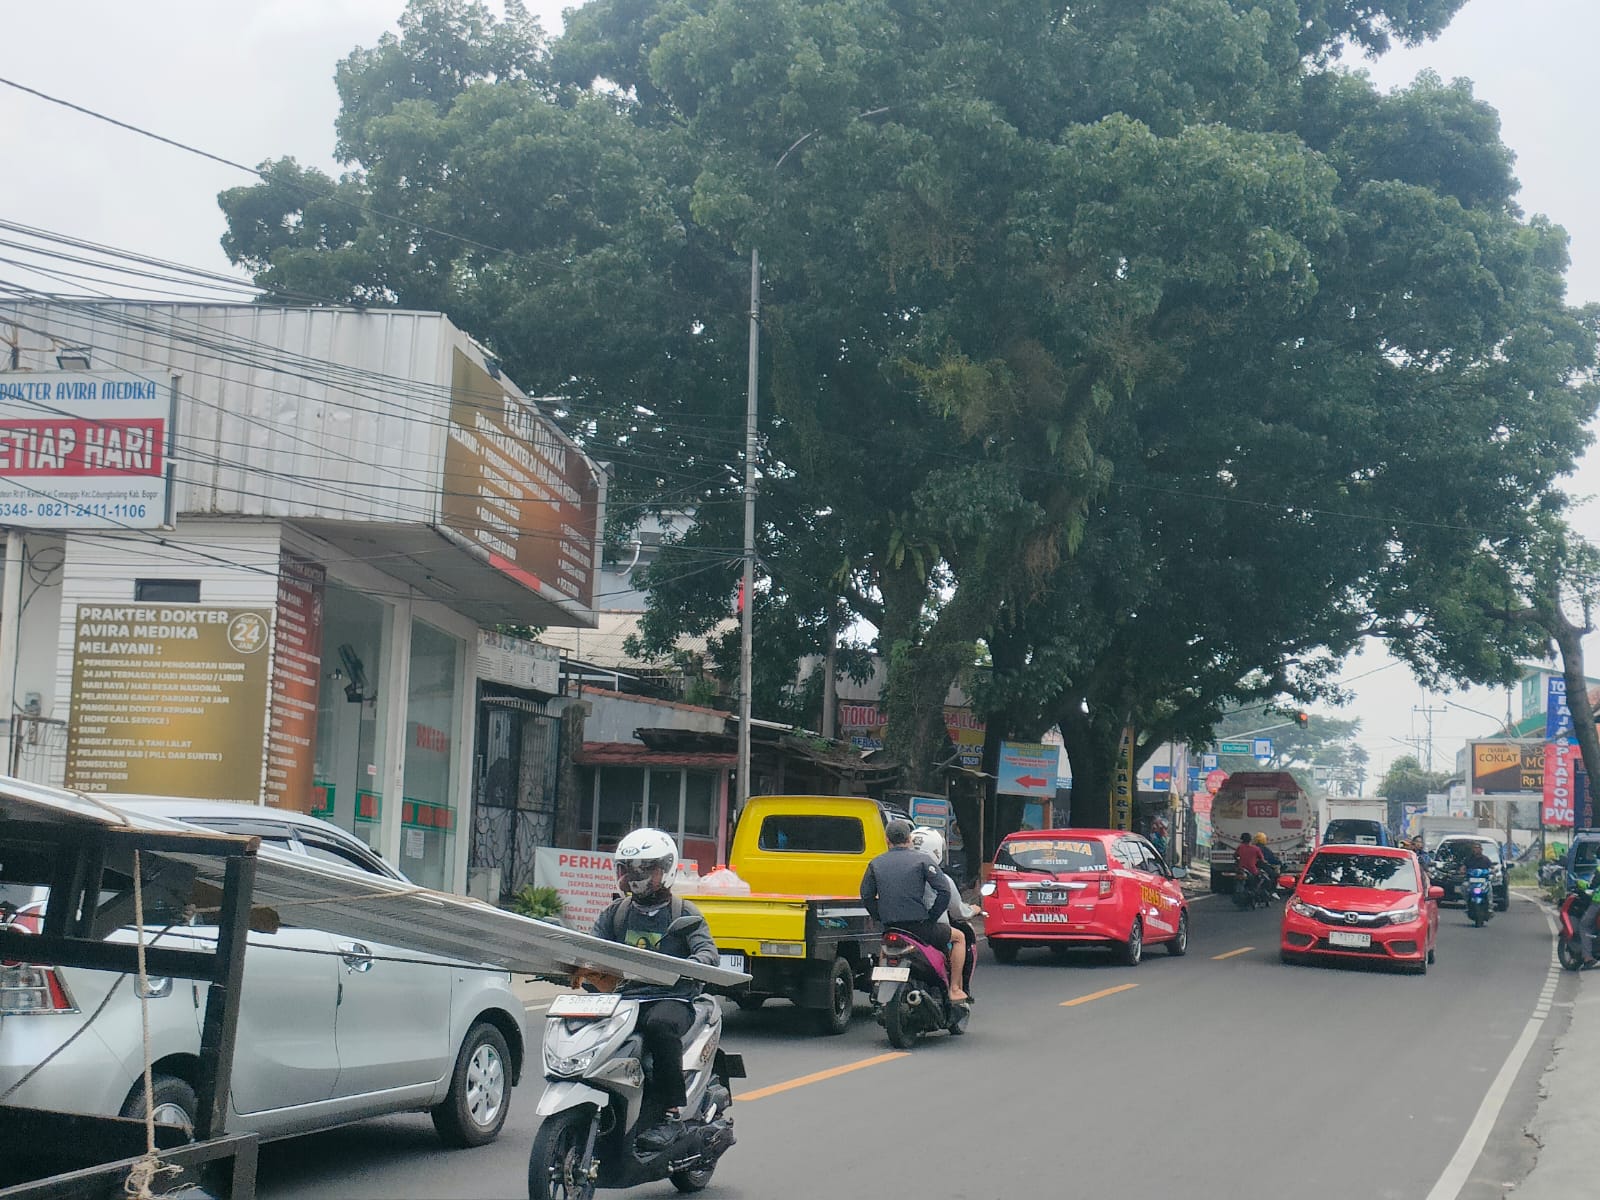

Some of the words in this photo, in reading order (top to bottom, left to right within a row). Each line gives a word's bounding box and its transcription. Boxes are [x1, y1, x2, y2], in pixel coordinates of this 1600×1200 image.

[0, 383, 51, 400] DOKTER
[56, 383, 96, 400] AVIRA
[102, 382, 156, 399] MEDIKA
[0, 427, 76, 469] ETIAP
[84, 427, 153, 469] HARI
[38, 503, 146, 518] 0821-2411-1106
[80, 607, 157, 621] PRAKTEK
[160, 610, 228, 623] DOKTER
[80, 624, 130, 637] AVIRA
[133, 626, 198, 639] MEDIKA
[233, 623, 260, 643] 24
[79, 641, 154, 655] MELAYANI
[1551, 680, 1566, 692] TO
[842, 705, 877, 727] TOKO
[1479, 753, 1518, 763] COKLAT
[1522, 776, 1535, 787] Rp
[1554, 746, 1570, 808] PLAFON
[1253, 805, 1273, 816] 135
[1545, 807, 1574, 822] PVC
[558, 854, 612, 871] PERHA
[594, 874, 615, 882] MEMB
[1022, 913, 1068, 923] LATIHAN
